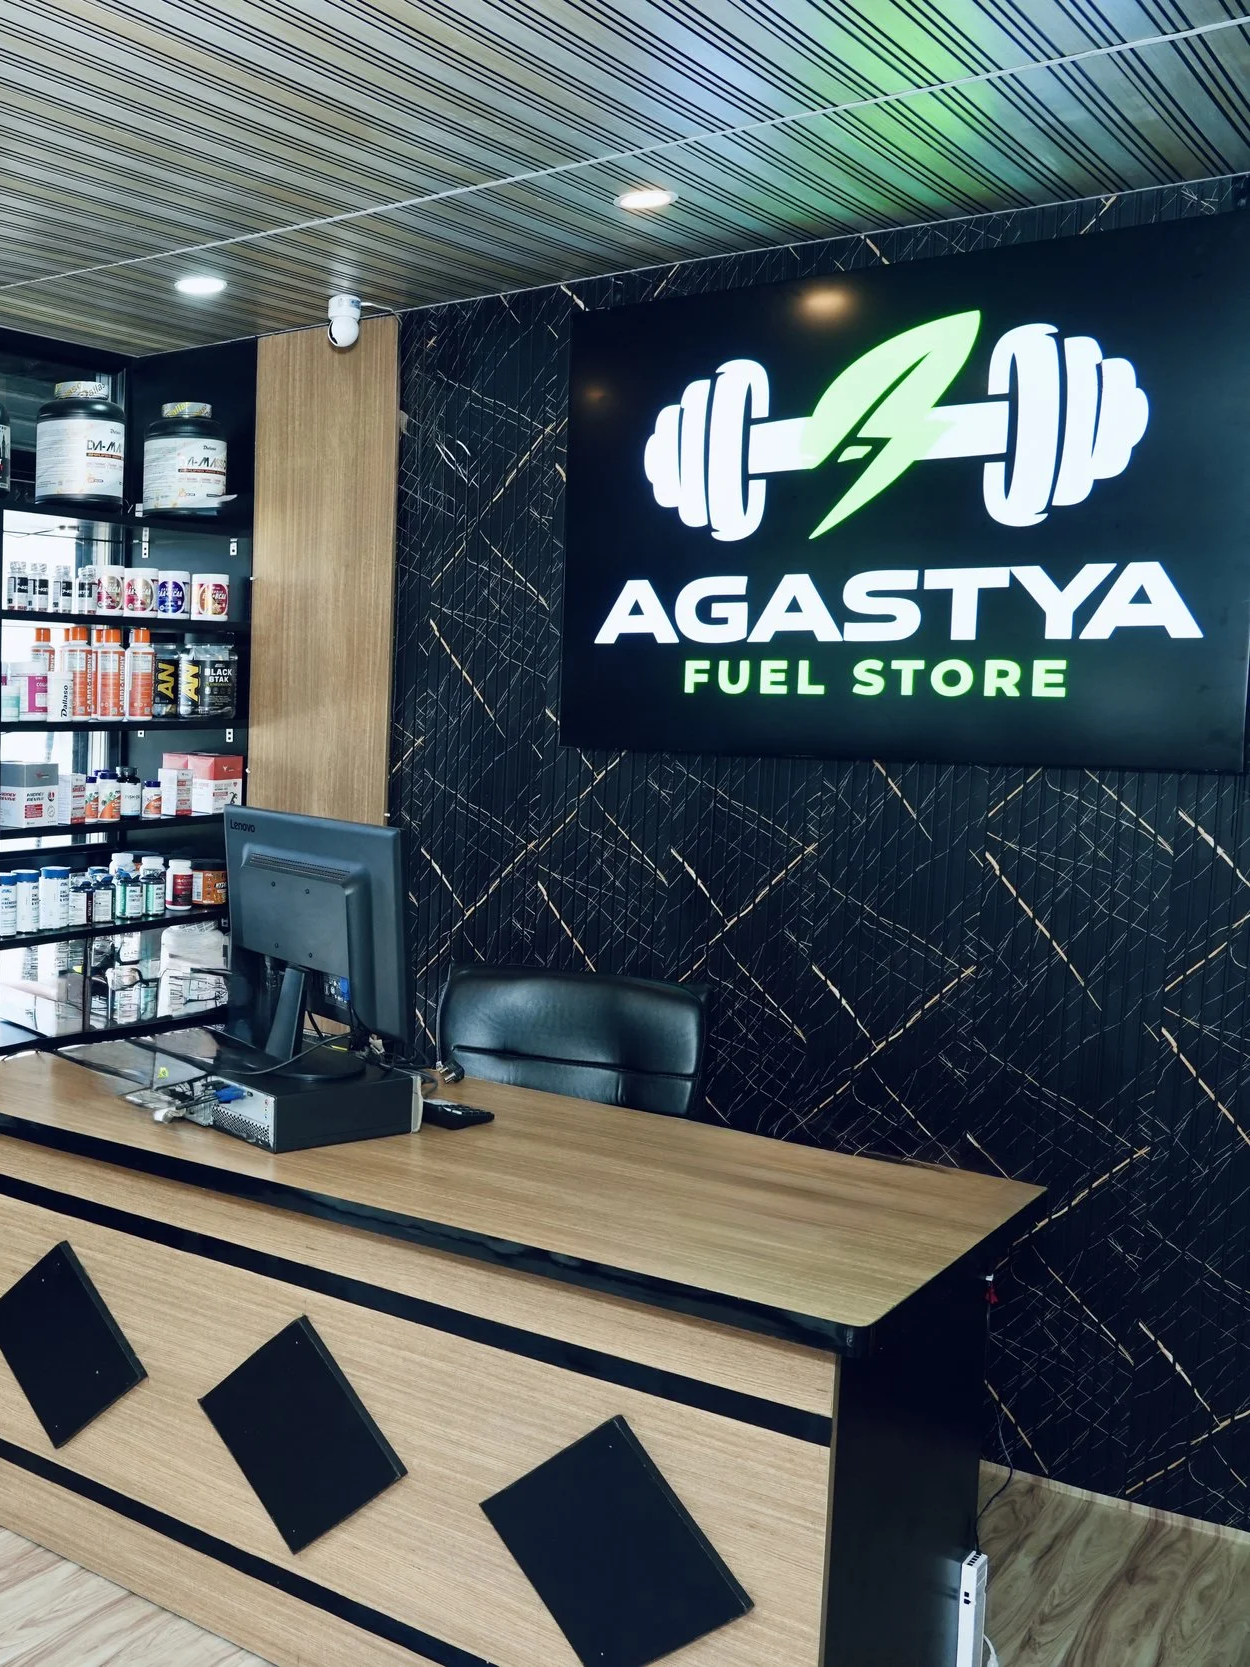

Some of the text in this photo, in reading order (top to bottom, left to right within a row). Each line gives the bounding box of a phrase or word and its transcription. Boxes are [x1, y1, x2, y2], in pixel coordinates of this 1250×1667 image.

[594, 561, 1204, 644] AGASTYA
[204, 668, 233, 676] BLACK
[684, 658, 1068, 698] FUEL STORE
[61, 684, 69, 718] Dallaso
[230, 819, 256, 833] Lenovo
